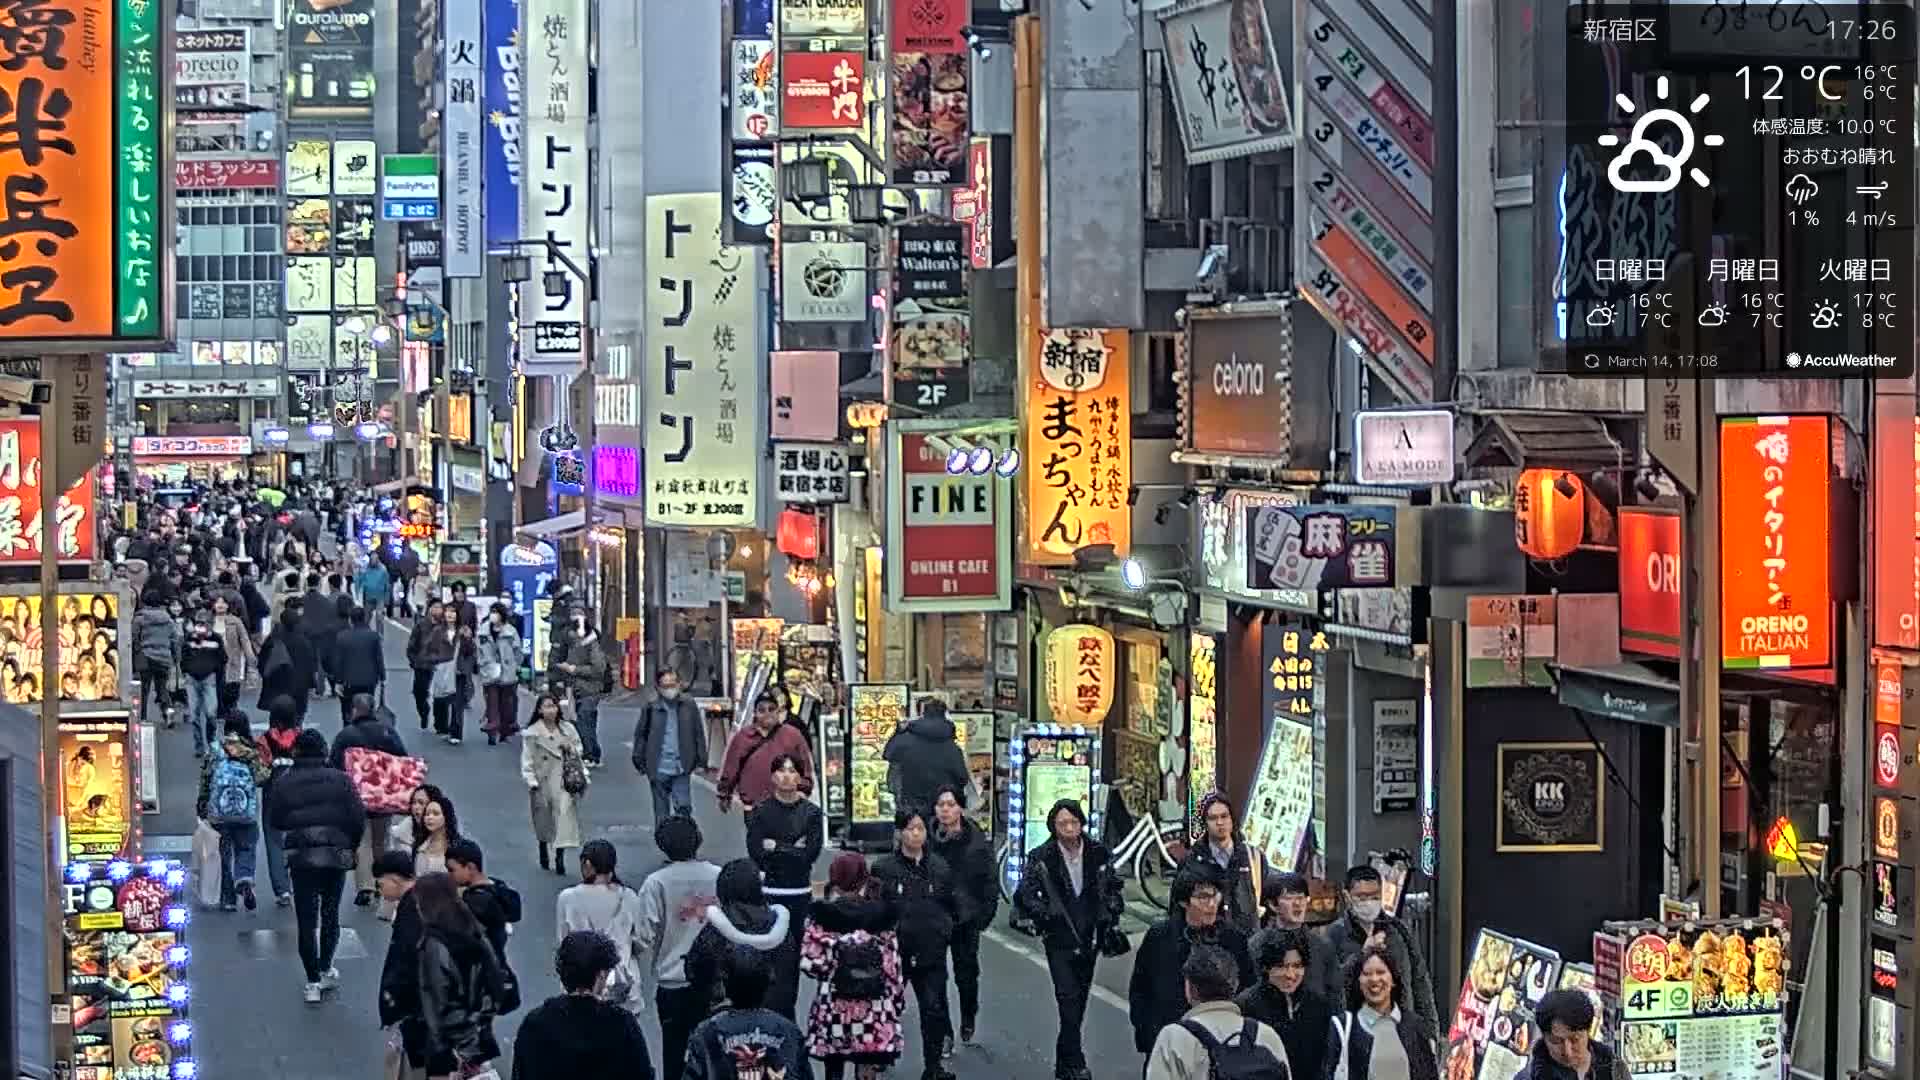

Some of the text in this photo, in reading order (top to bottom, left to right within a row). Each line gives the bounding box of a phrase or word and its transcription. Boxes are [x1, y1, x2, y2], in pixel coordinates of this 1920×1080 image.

[296, 12, 370, 25] auralume
[1315, 22, 1334, 43] 5
[809, 39, 837, 51] 2F
[450, 38, 477, 105] 火鍋
[831, 59, 860, 121] 牛門
[1314, 75, 1334, 91] 4
[1357, 118, 1413, 180] センチュリー
[1315, 122, 1334, 142] 3
[177, 162, 269, 175] ルドラッシュ
[913, 170, 950, 183] 3F
[386, 182, 435, 192] FamilyMart
[1314, 172, 1334, 193] 2
[407, 204, 435, 216] たばこ
[456, 204, 470, 255] HOTPOT
[541, 135, 572, 311] トントン
[810, 231, 838, 241] B1
[902, 255, 960, 271] Walton's
[659, 210, 695, 463] トントン
[712, 323, 737, 444] 焼とん酒場
[1213, 352, 1264, 395] celona
[917, 385, 948, 404] 2F
[1395, 422, 1413, 449] A
[780, 450, 844, 471] 酒場心
[1040, 396, 1086, 545] まっちゃん
[779, 476, 844, 493] 新宿本店
[912, 485, 986, 513] FINE
[1350, 518, 1390, 535] フリー
[1755, 431, 1789, 605] 俺のイタリアン
[911, 560, 988, 575] ONLINE CAFE
[943, 580, 958, 593] B1
[1741, 615, 1808, 634] ORENO
[1740, 634, 1808, 650] ITALIAN
[1535, 782, 1564, 801] KK
[1628, 989, 1661, 1012] 4F
